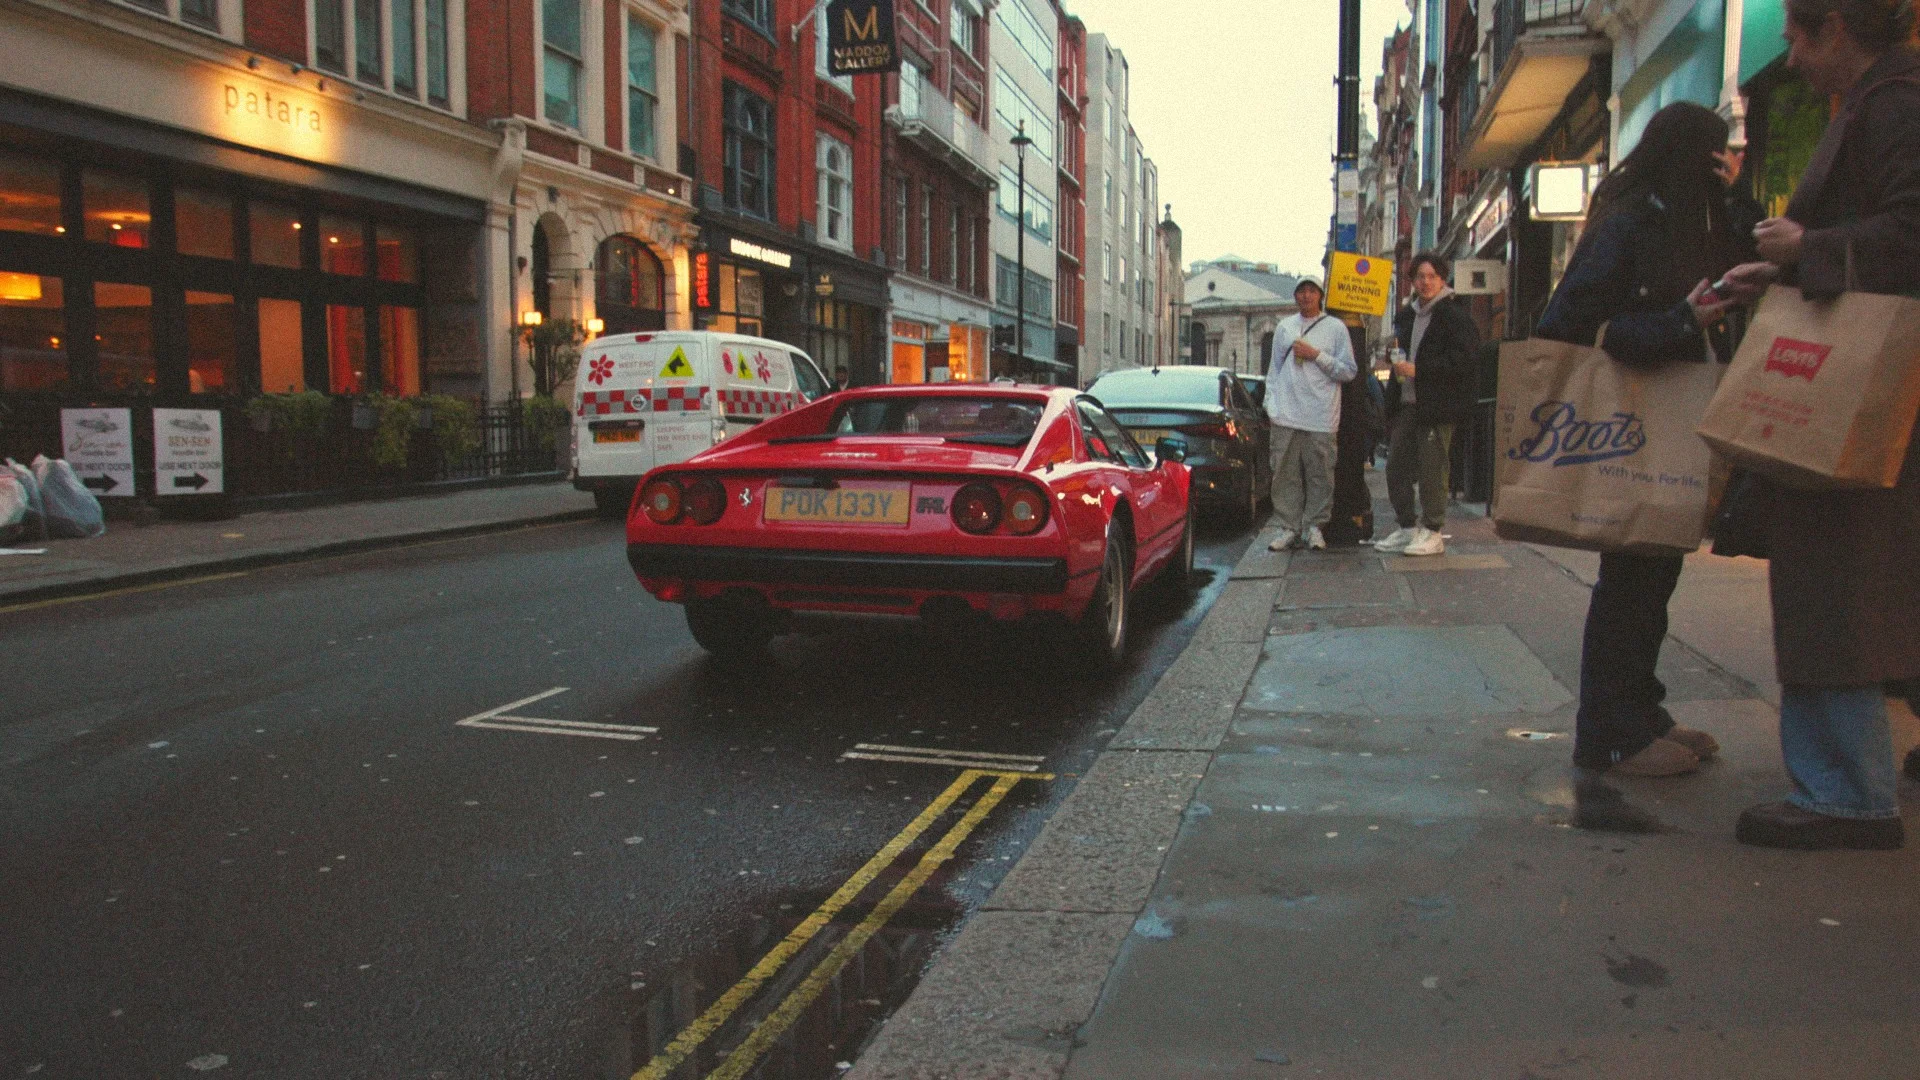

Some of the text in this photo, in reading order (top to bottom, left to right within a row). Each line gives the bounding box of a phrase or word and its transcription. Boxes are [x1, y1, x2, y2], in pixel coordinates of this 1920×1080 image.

[844, 4, 879, 41] M
[834, 44, 890, 59] MADDOX
[224, 84, 321, 132] patara
[695, 252, 711, 307] patara
[1337, 282, 1380, 297] WARNING
[618, 360, 653, 369] WEST END
[1508, 400, 1646, 467] Boots
[85, 462, 105, 471] NEXT
[107, 462, 132, 471] DOOR
[177, 461, 197, 471] NEXT
[198, 461, 221, 470] DOOR
[1598, 465, 1629, 479] With
[1659, 473, 1678, 486] For
[835, 490, 893, 518] 133Y
